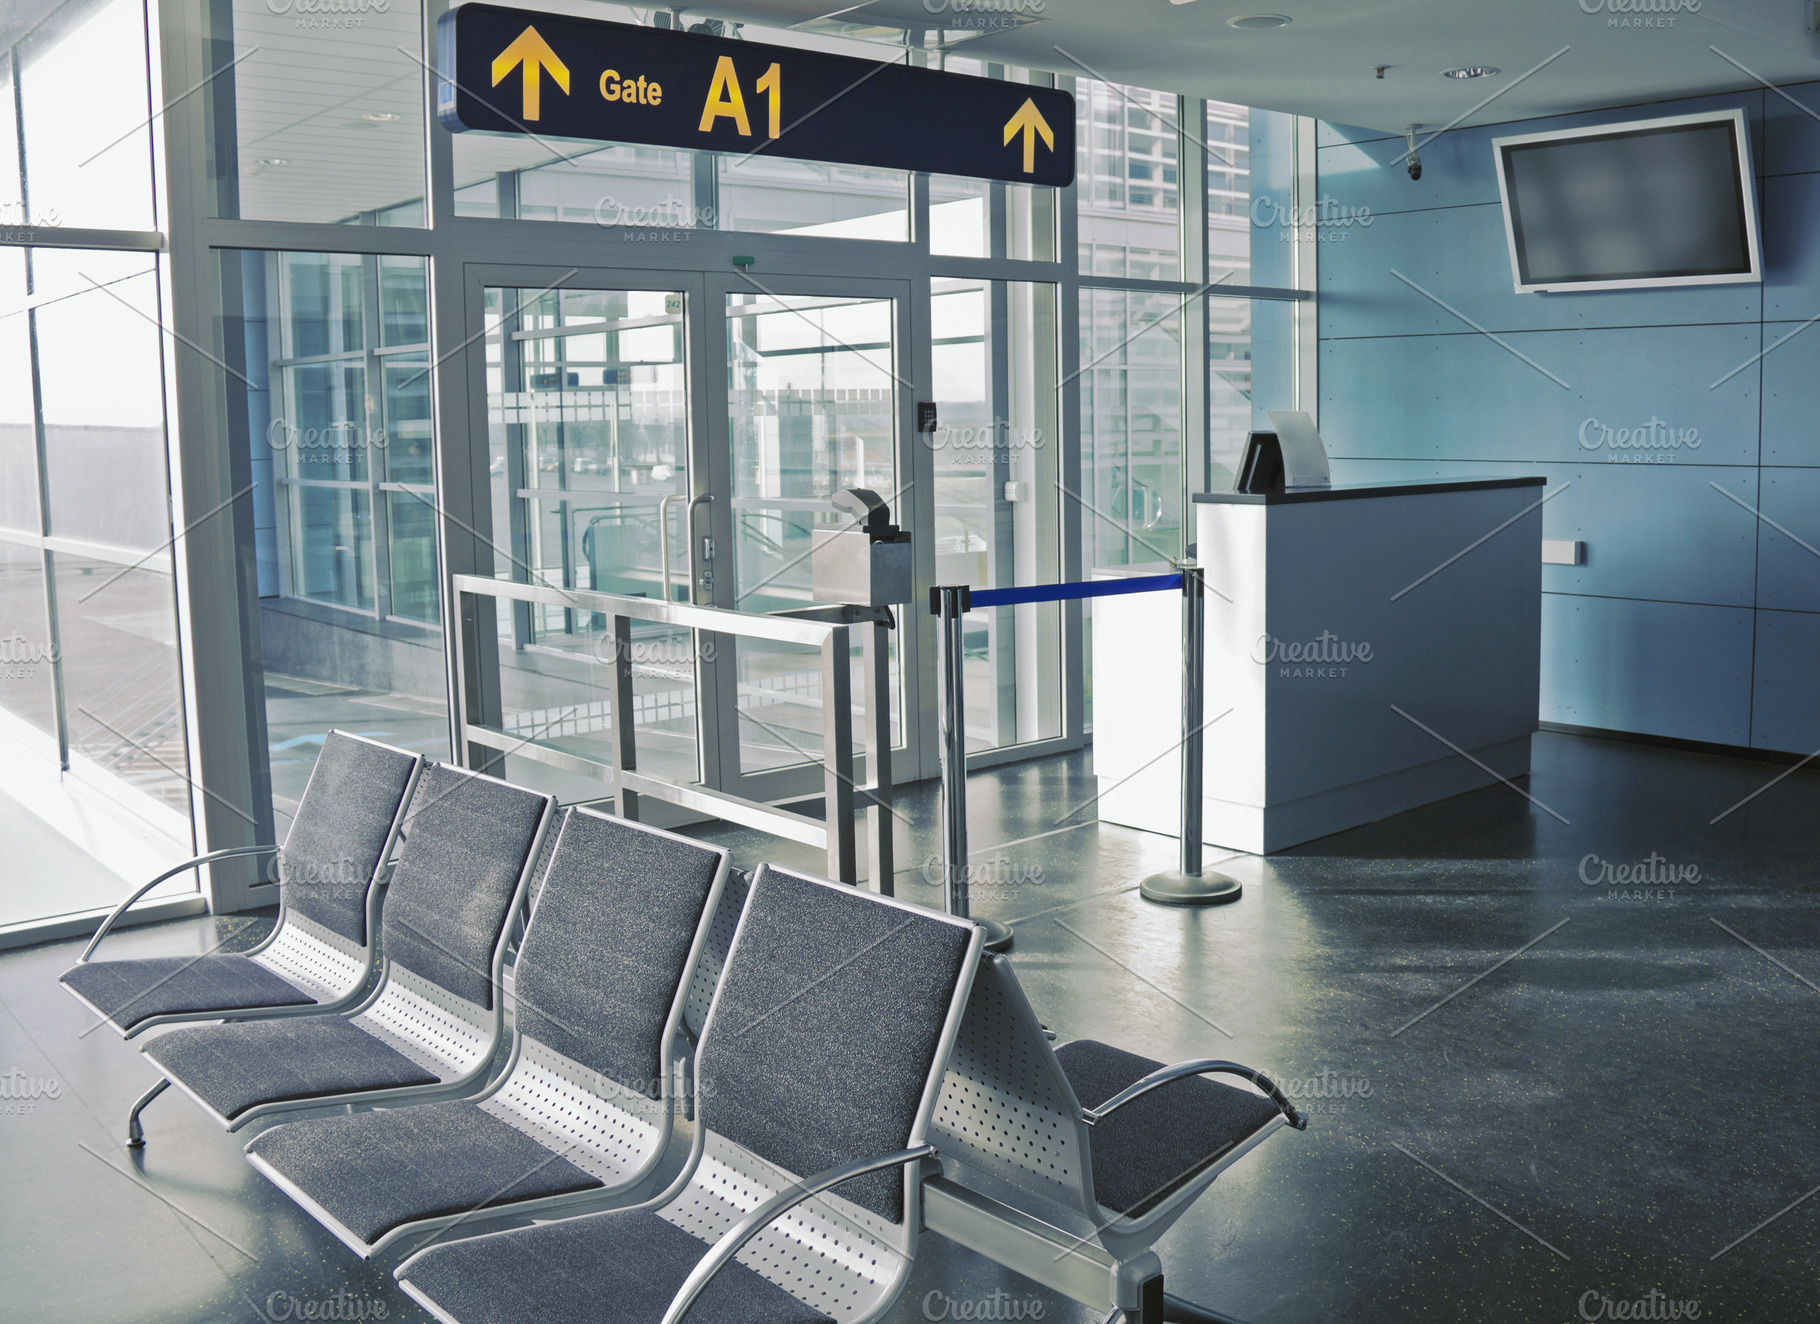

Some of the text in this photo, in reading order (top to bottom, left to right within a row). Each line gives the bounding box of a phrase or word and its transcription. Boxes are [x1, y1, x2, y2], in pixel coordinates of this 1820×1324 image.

[600, 55, 780, 139] Gate A1
[667, 300, 680, 308] 242
